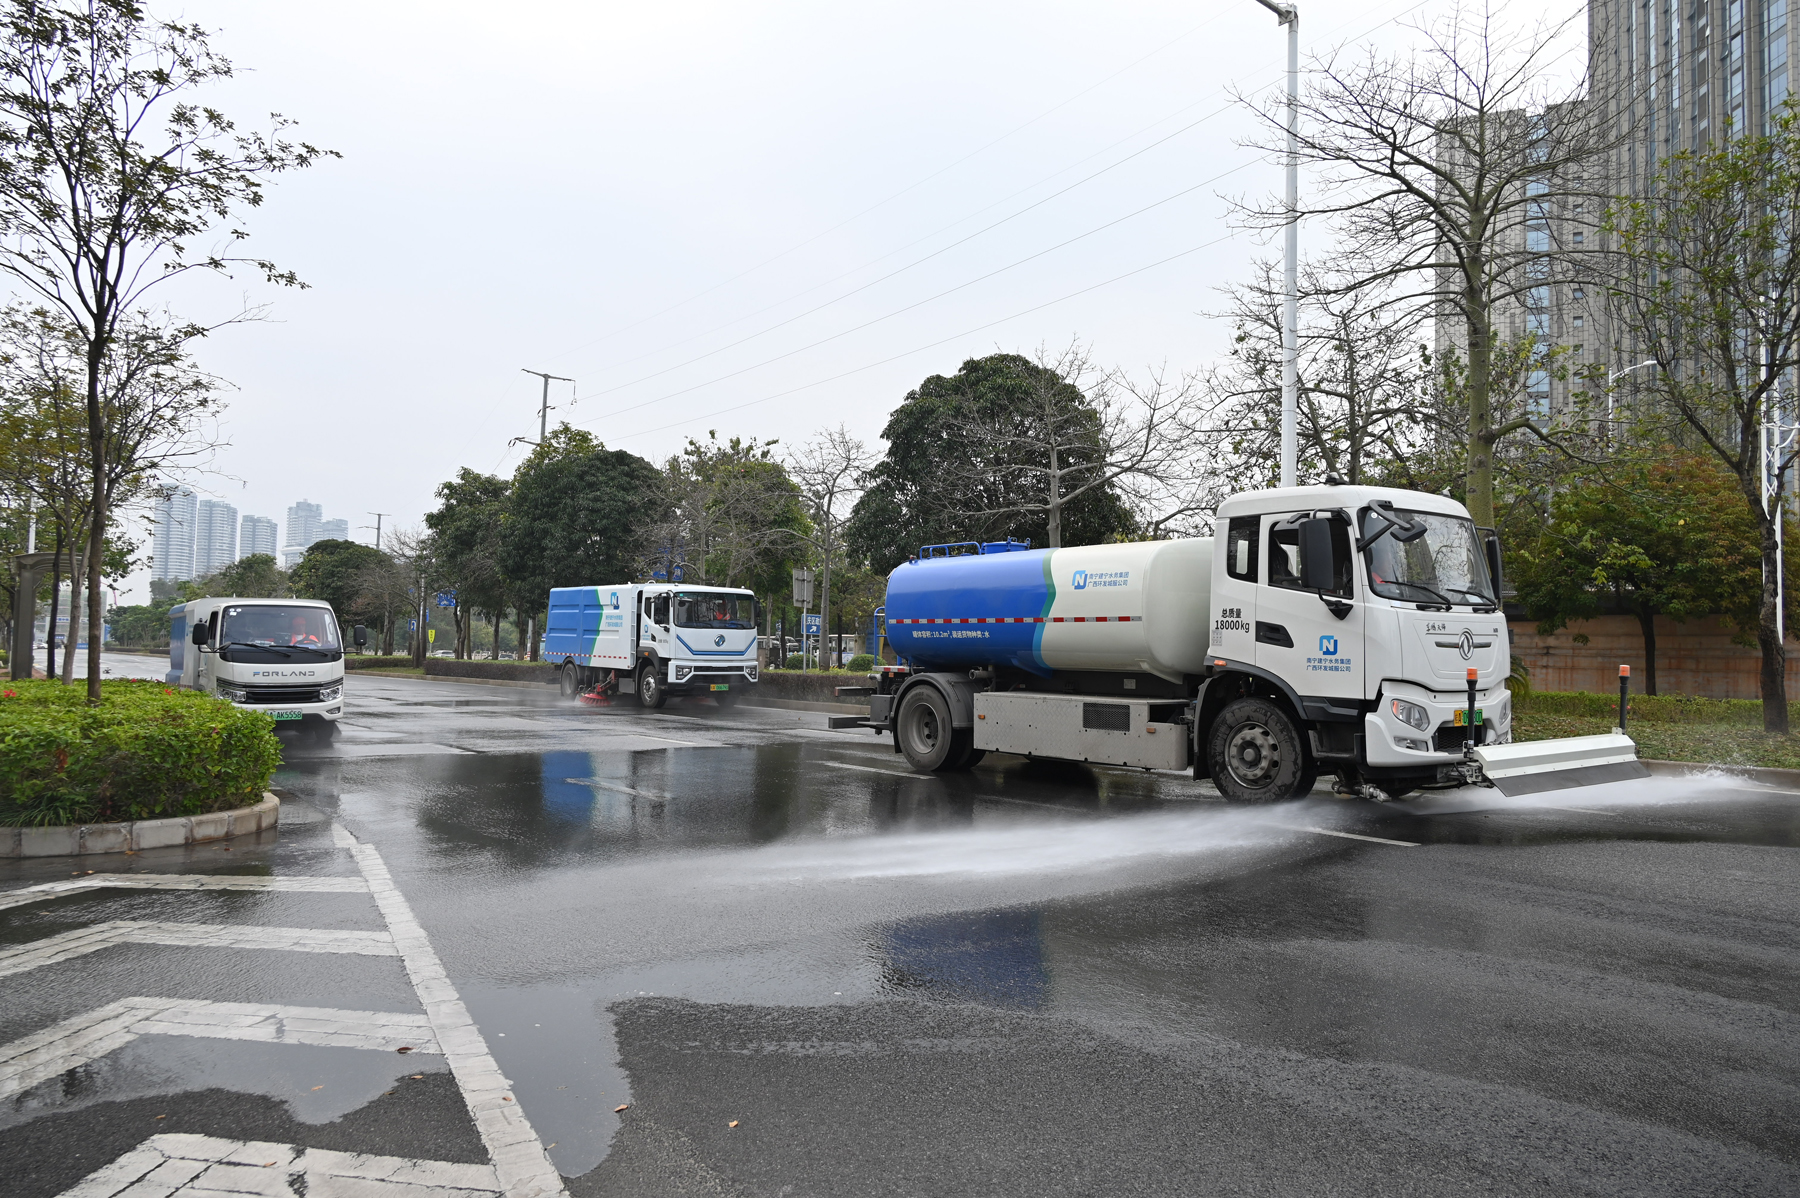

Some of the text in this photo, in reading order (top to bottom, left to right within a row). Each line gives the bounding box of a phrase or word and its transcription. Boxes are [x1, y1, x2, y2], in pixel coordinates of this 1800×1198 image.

[1221, 608, 1242, 618] 总质量
[1215, 619, 1250, 633] 18000kg
[1306, 657, 1352, 665] 南宁建宁水务集团
[1306, 665, 1352, 673] 广西环发城服公司
